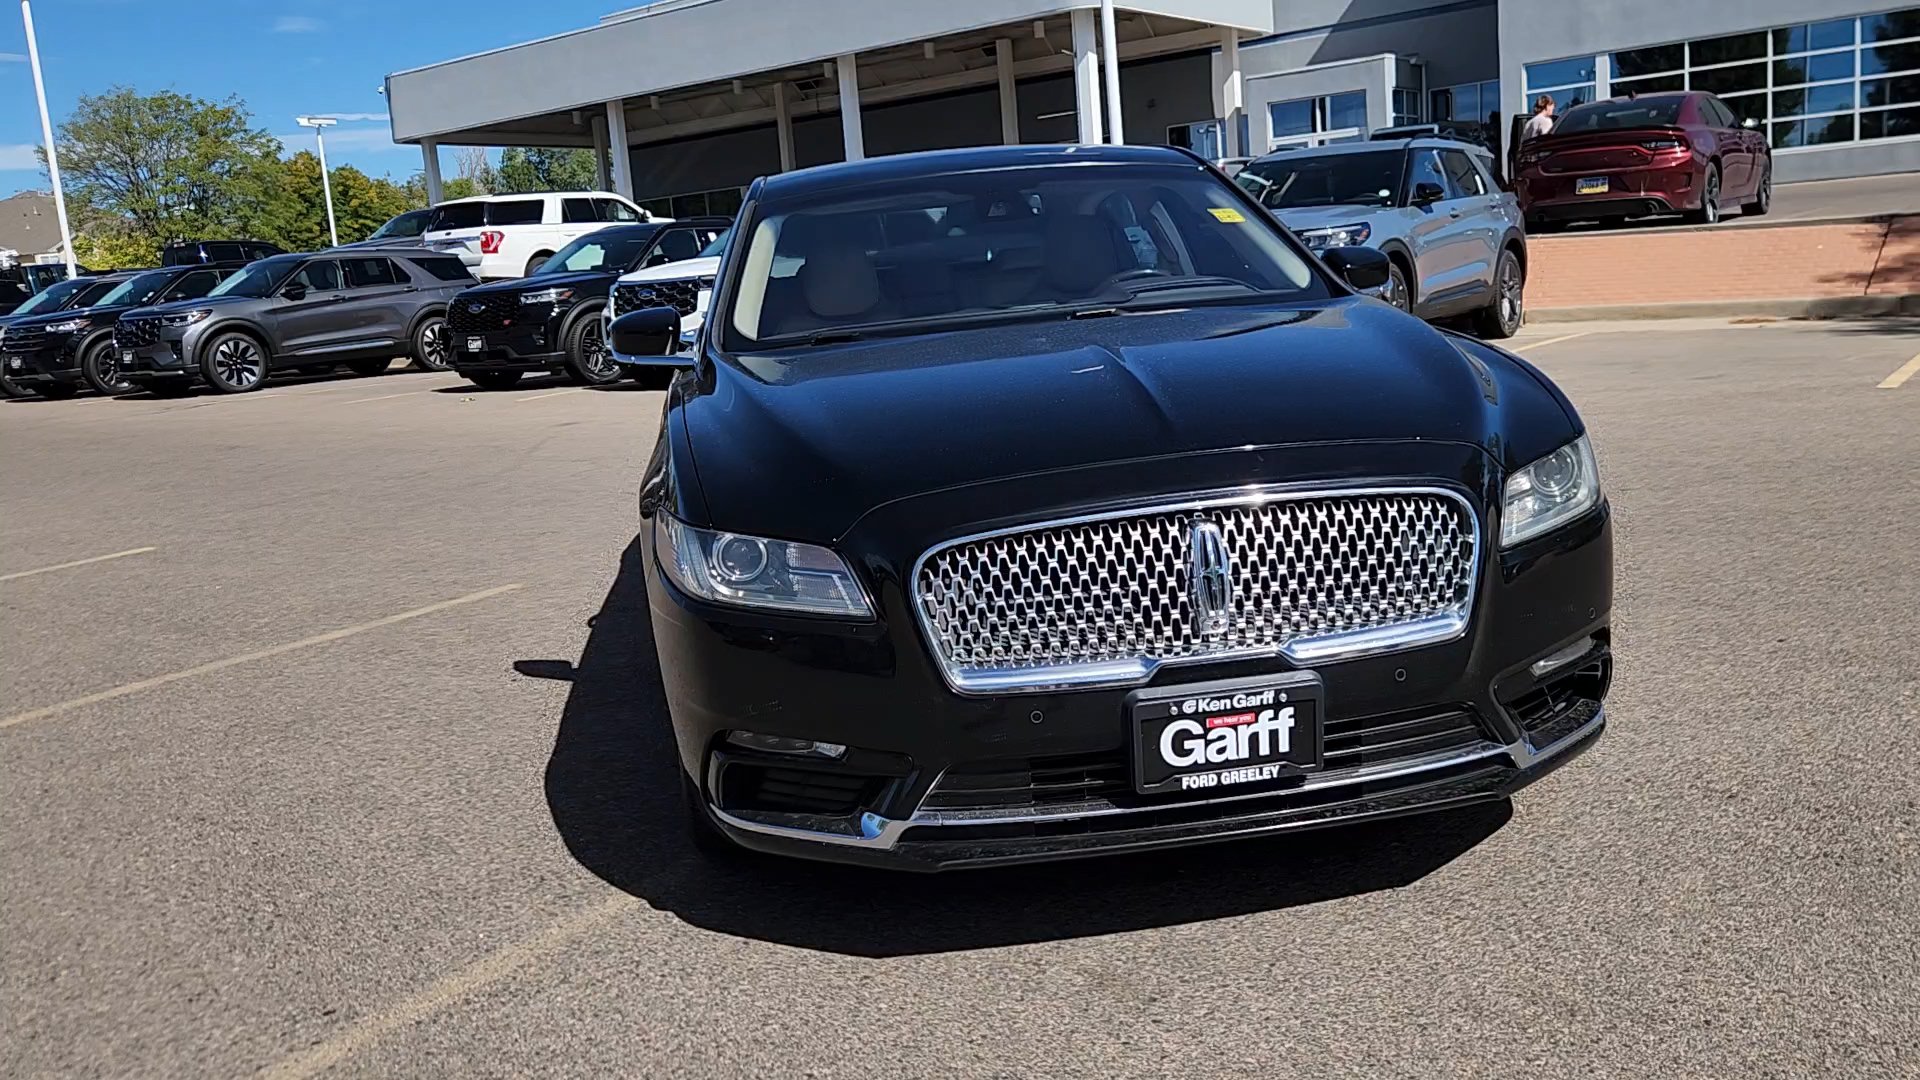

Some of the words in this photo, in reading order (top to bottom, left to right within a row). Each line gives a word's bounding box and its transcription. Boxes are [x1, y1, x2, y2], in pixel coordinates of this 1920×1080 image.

[1198, 698, 1231, 712] Ken
[1233, 690, 1275, 708] Garff
[1160, 707, 1295, 767] Garff
[1182, 774, 1218, 790] FORD
[1220, 765, 1280, 785] GREELEY
